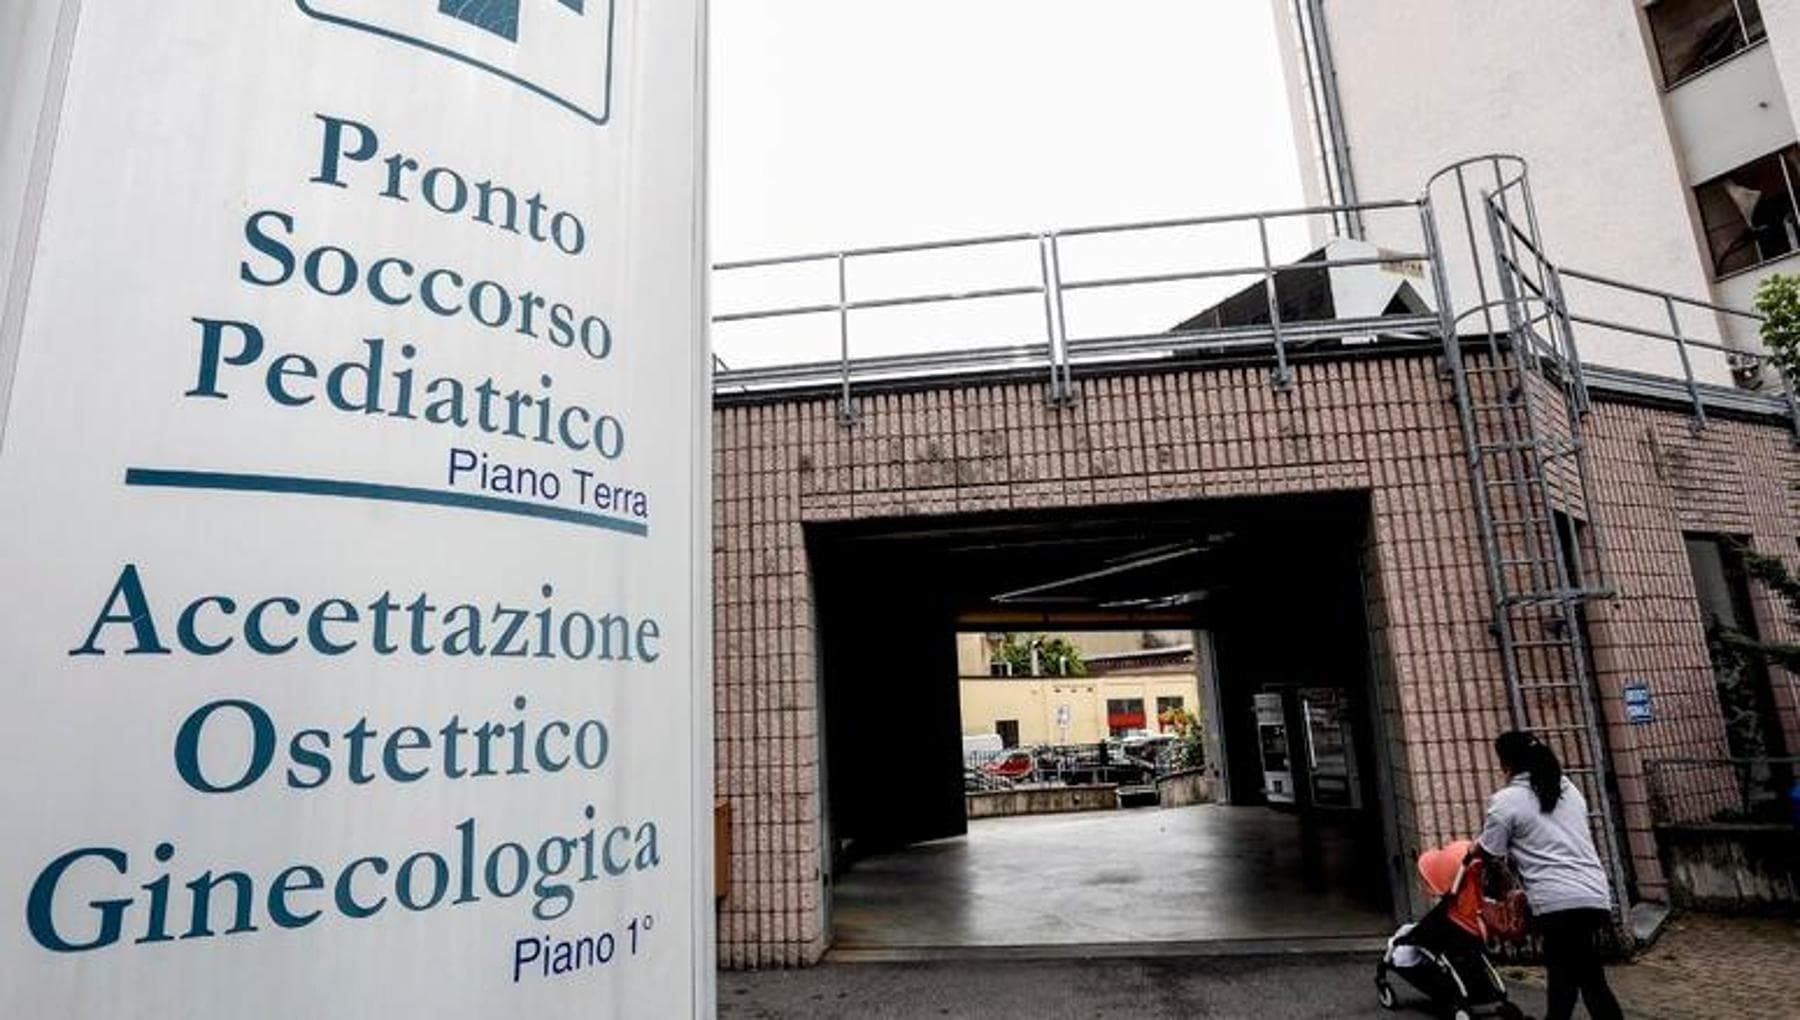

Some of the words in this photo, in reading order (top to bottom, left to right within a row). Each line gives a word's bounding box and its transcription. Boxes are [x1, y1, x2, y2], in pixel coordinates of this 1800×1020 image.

[309, 113, 586, 255] Pronto
[240, 210, 612, 359] Soccorso
[184, 316, 625, 460] Pediatrico
[447, 448, 560, 500] Piano
[573, 469, 649, 519] Terra
[68, 563, 660, 663] Accettazione
[173, 695, 609, 794] Ostetrico
[26, 805, 660, 953] Ginecologica
[513, 933, 615, 983] Piano
